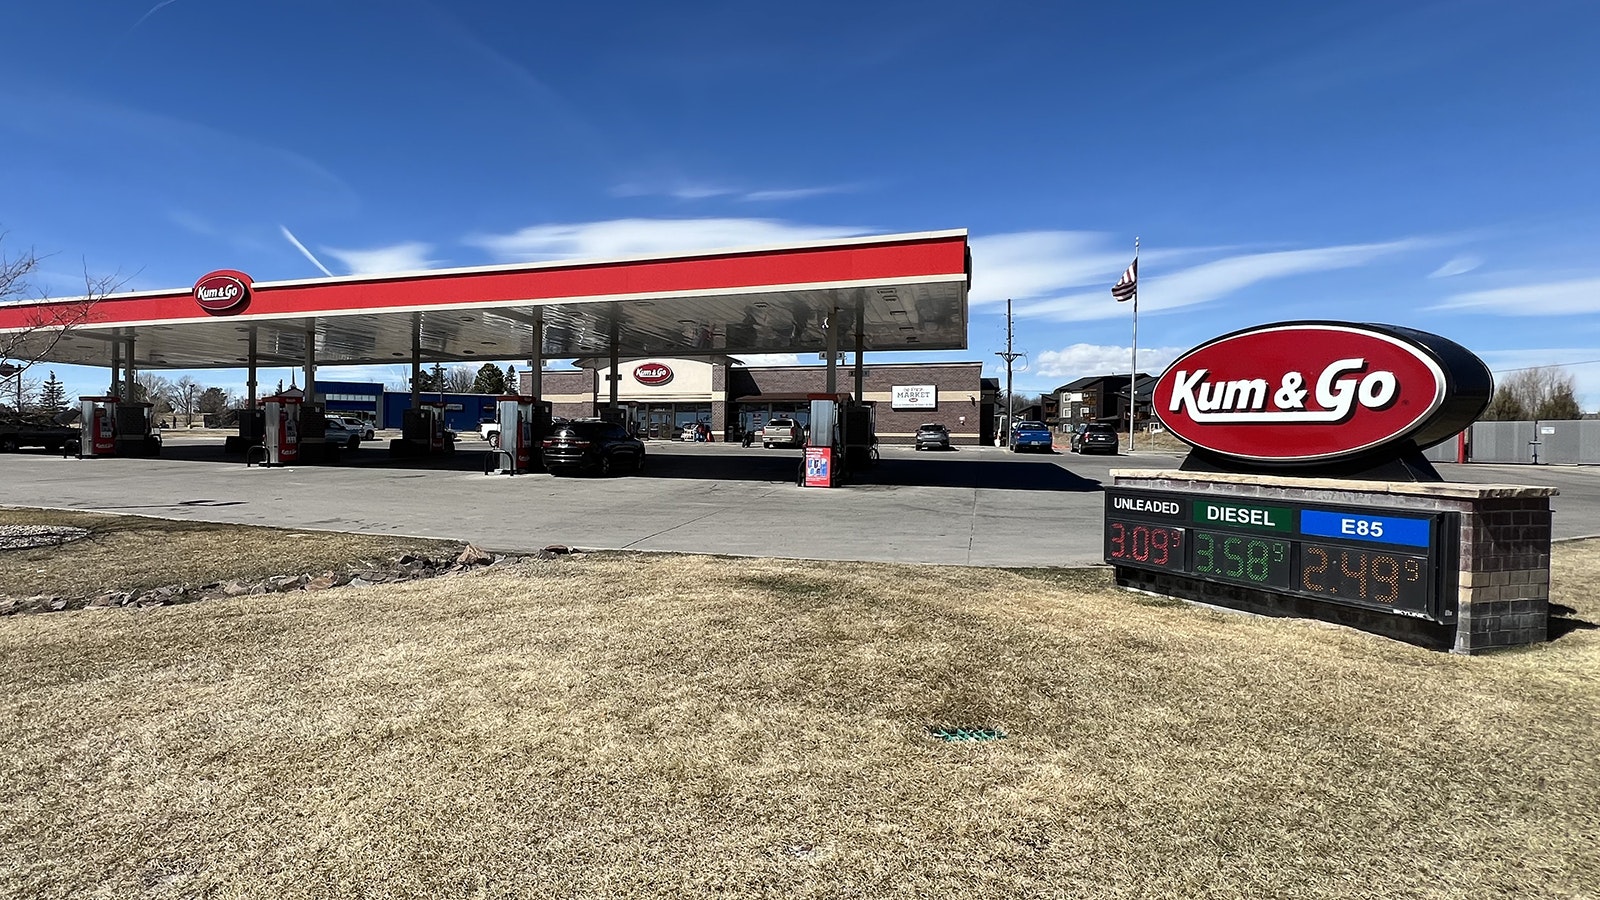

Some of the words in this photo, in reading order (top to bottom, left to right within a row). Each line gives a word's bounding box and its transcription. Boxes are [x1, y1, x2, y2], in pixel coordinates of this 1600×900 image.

[197, 286, 218, 299] Kum
[218, 287, 225, 297] &
[225, 284, 238, 298] Go
[657, 368, 667, 377] Go
[1169, 369, 1267, 413] Kum
[1273, 371, 1308, 410] &
[1315, 358, 1397, 415] Go
[1114, 498, 1180, 515] UNLEADED
[1207, 506, 1275, 527] DIESEL
[1341, 518, 1383, 537] E85
